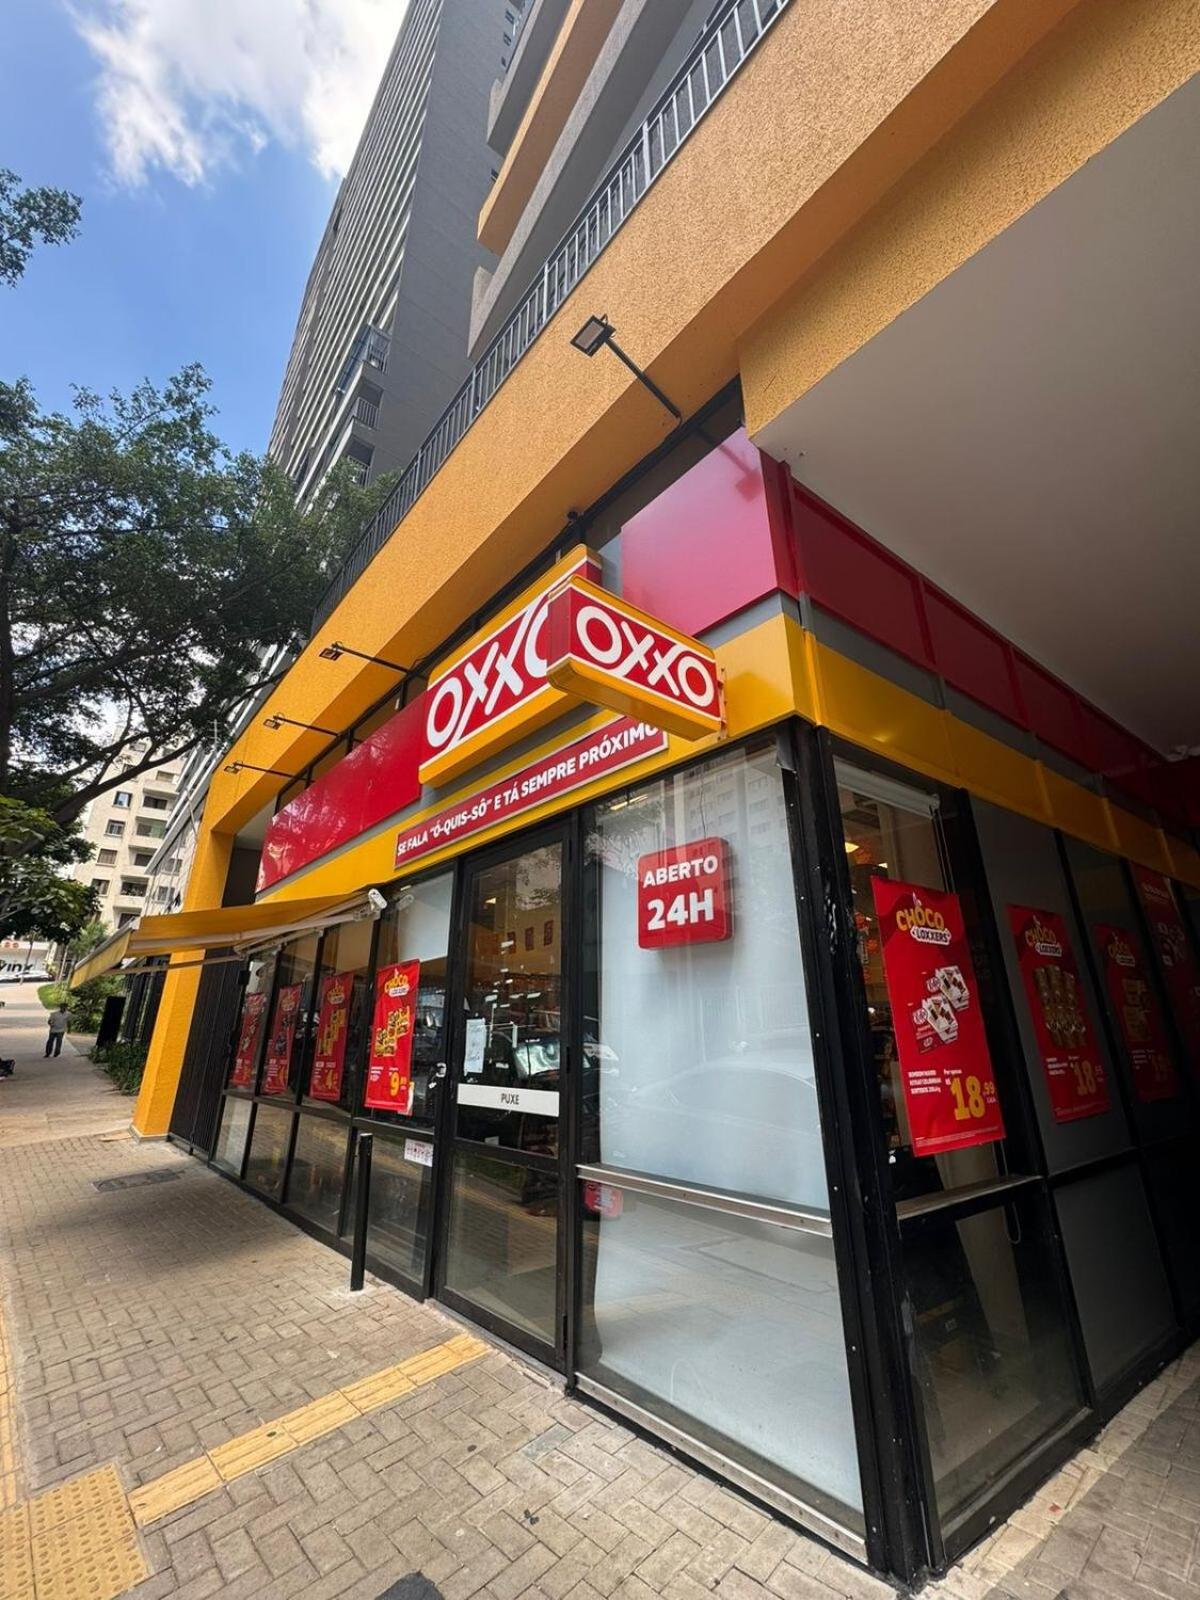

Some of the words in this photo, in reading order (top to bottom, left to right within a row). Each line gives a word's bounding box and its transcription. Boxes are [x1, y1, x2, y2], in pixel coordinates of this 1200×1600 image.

[576, 605, 715, 707] OXXO
[397, 842, 407, 857] SE
[406, 831, 429, 851] FALA
[494, 794, 502, 811] E
[503, 780, 520, 806] TÁ
[520, 756, 577, 798] SEMPRE
[642, 855, 718, 889] ABERTO
[647, 888, 714, 931] 24H
[896, 906, 945, 931] CHOCO
[500, 1092, 520, 1105] PUXE
[950, 1075, 985, 1120] 18
